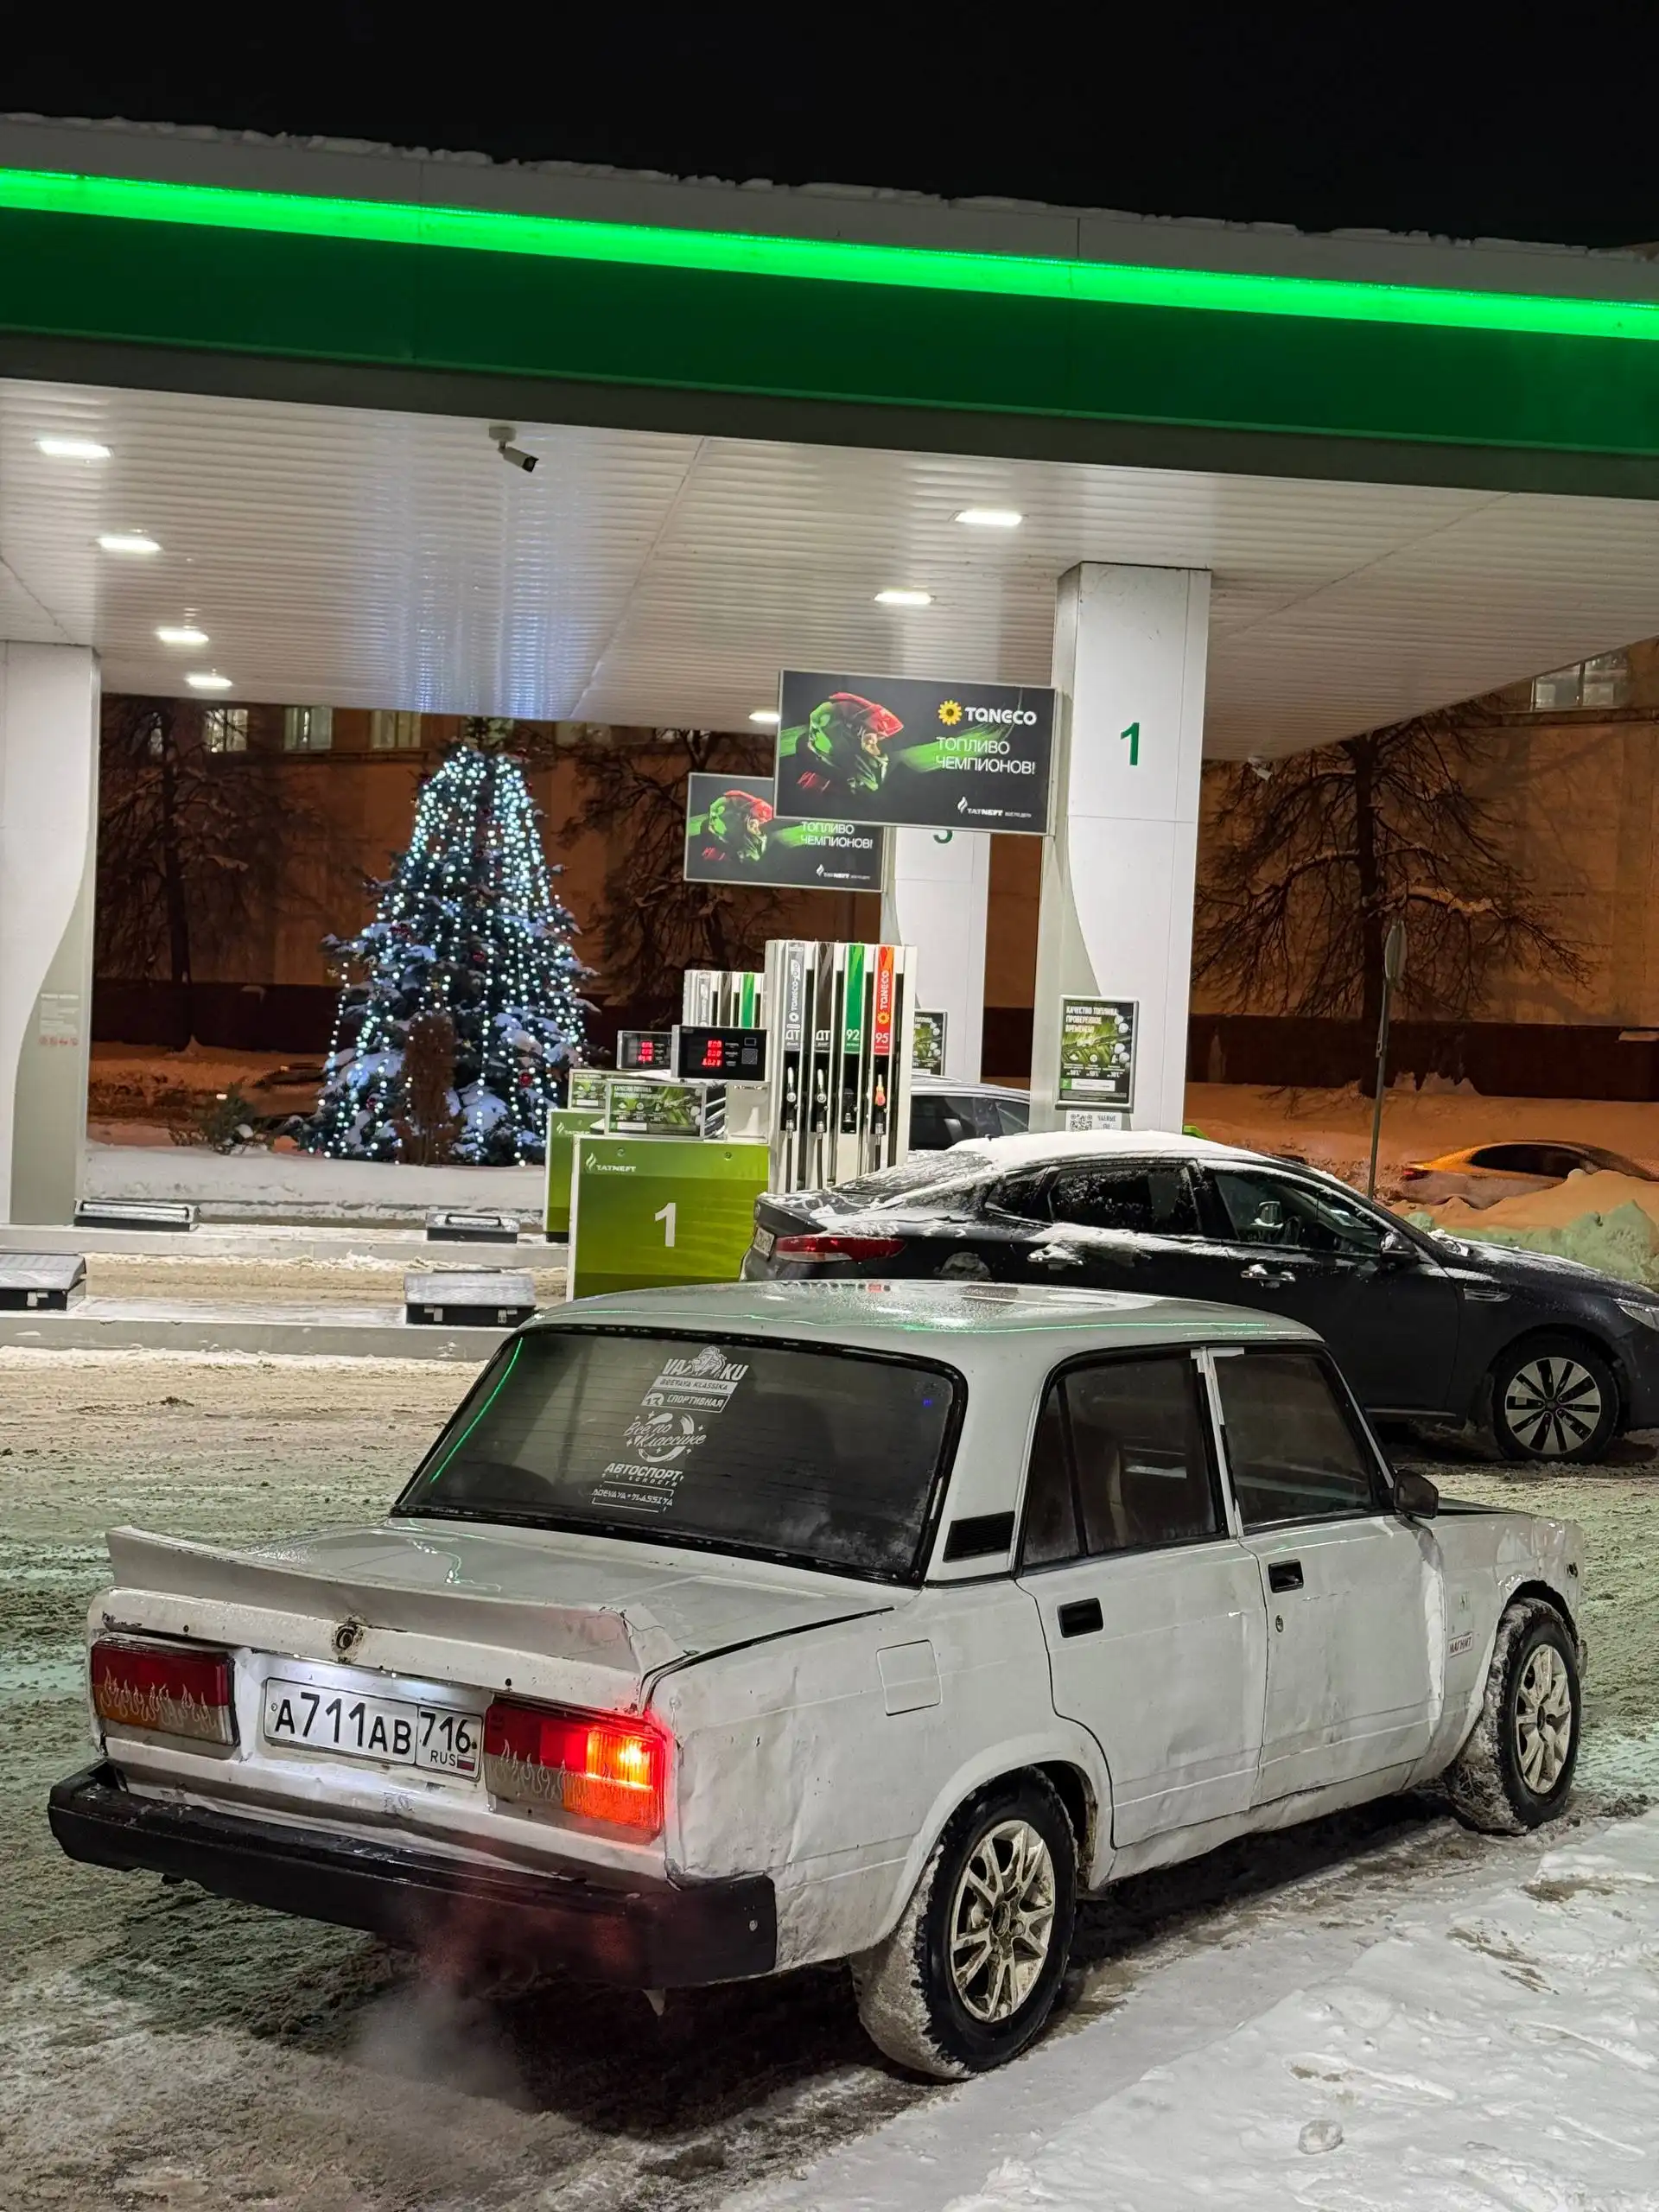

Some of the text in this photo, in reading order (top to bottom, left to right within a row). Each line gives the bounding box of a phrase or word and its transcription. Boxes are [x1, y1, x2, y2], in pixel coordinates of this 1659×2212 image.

[964, 707, 1037, 726] TANECO
[936, 736, 1011, 755] ТОПЛИВО
[1120, 721, 1140, 766] 1
[935, 755, 1036, 775] ЧЕМПИОНОВ!
[967, 808, 1003, 817] TATNEFT
[801, 821, 855, 836] ТОПЛИВО
[800, 835, 874, 849] ЧЕМПИОНОВ!
[880, 970, 890, 1010] TANECO
[815, 1030, 830, 1041] ДТ
[846, 1029, 860, 1041] 92
[875, 1033, 889, 1044] 95
[654, 1202, 677, 1248] 1
[666, 1393, 725, 1408] СПОРТИВНАЯ
[604, 1462, 683, 1481] АВТОСПОРТ
[274, 1691, 472, 1756] А711АВ 716
[429, 1751, 457, 1766] RUS
